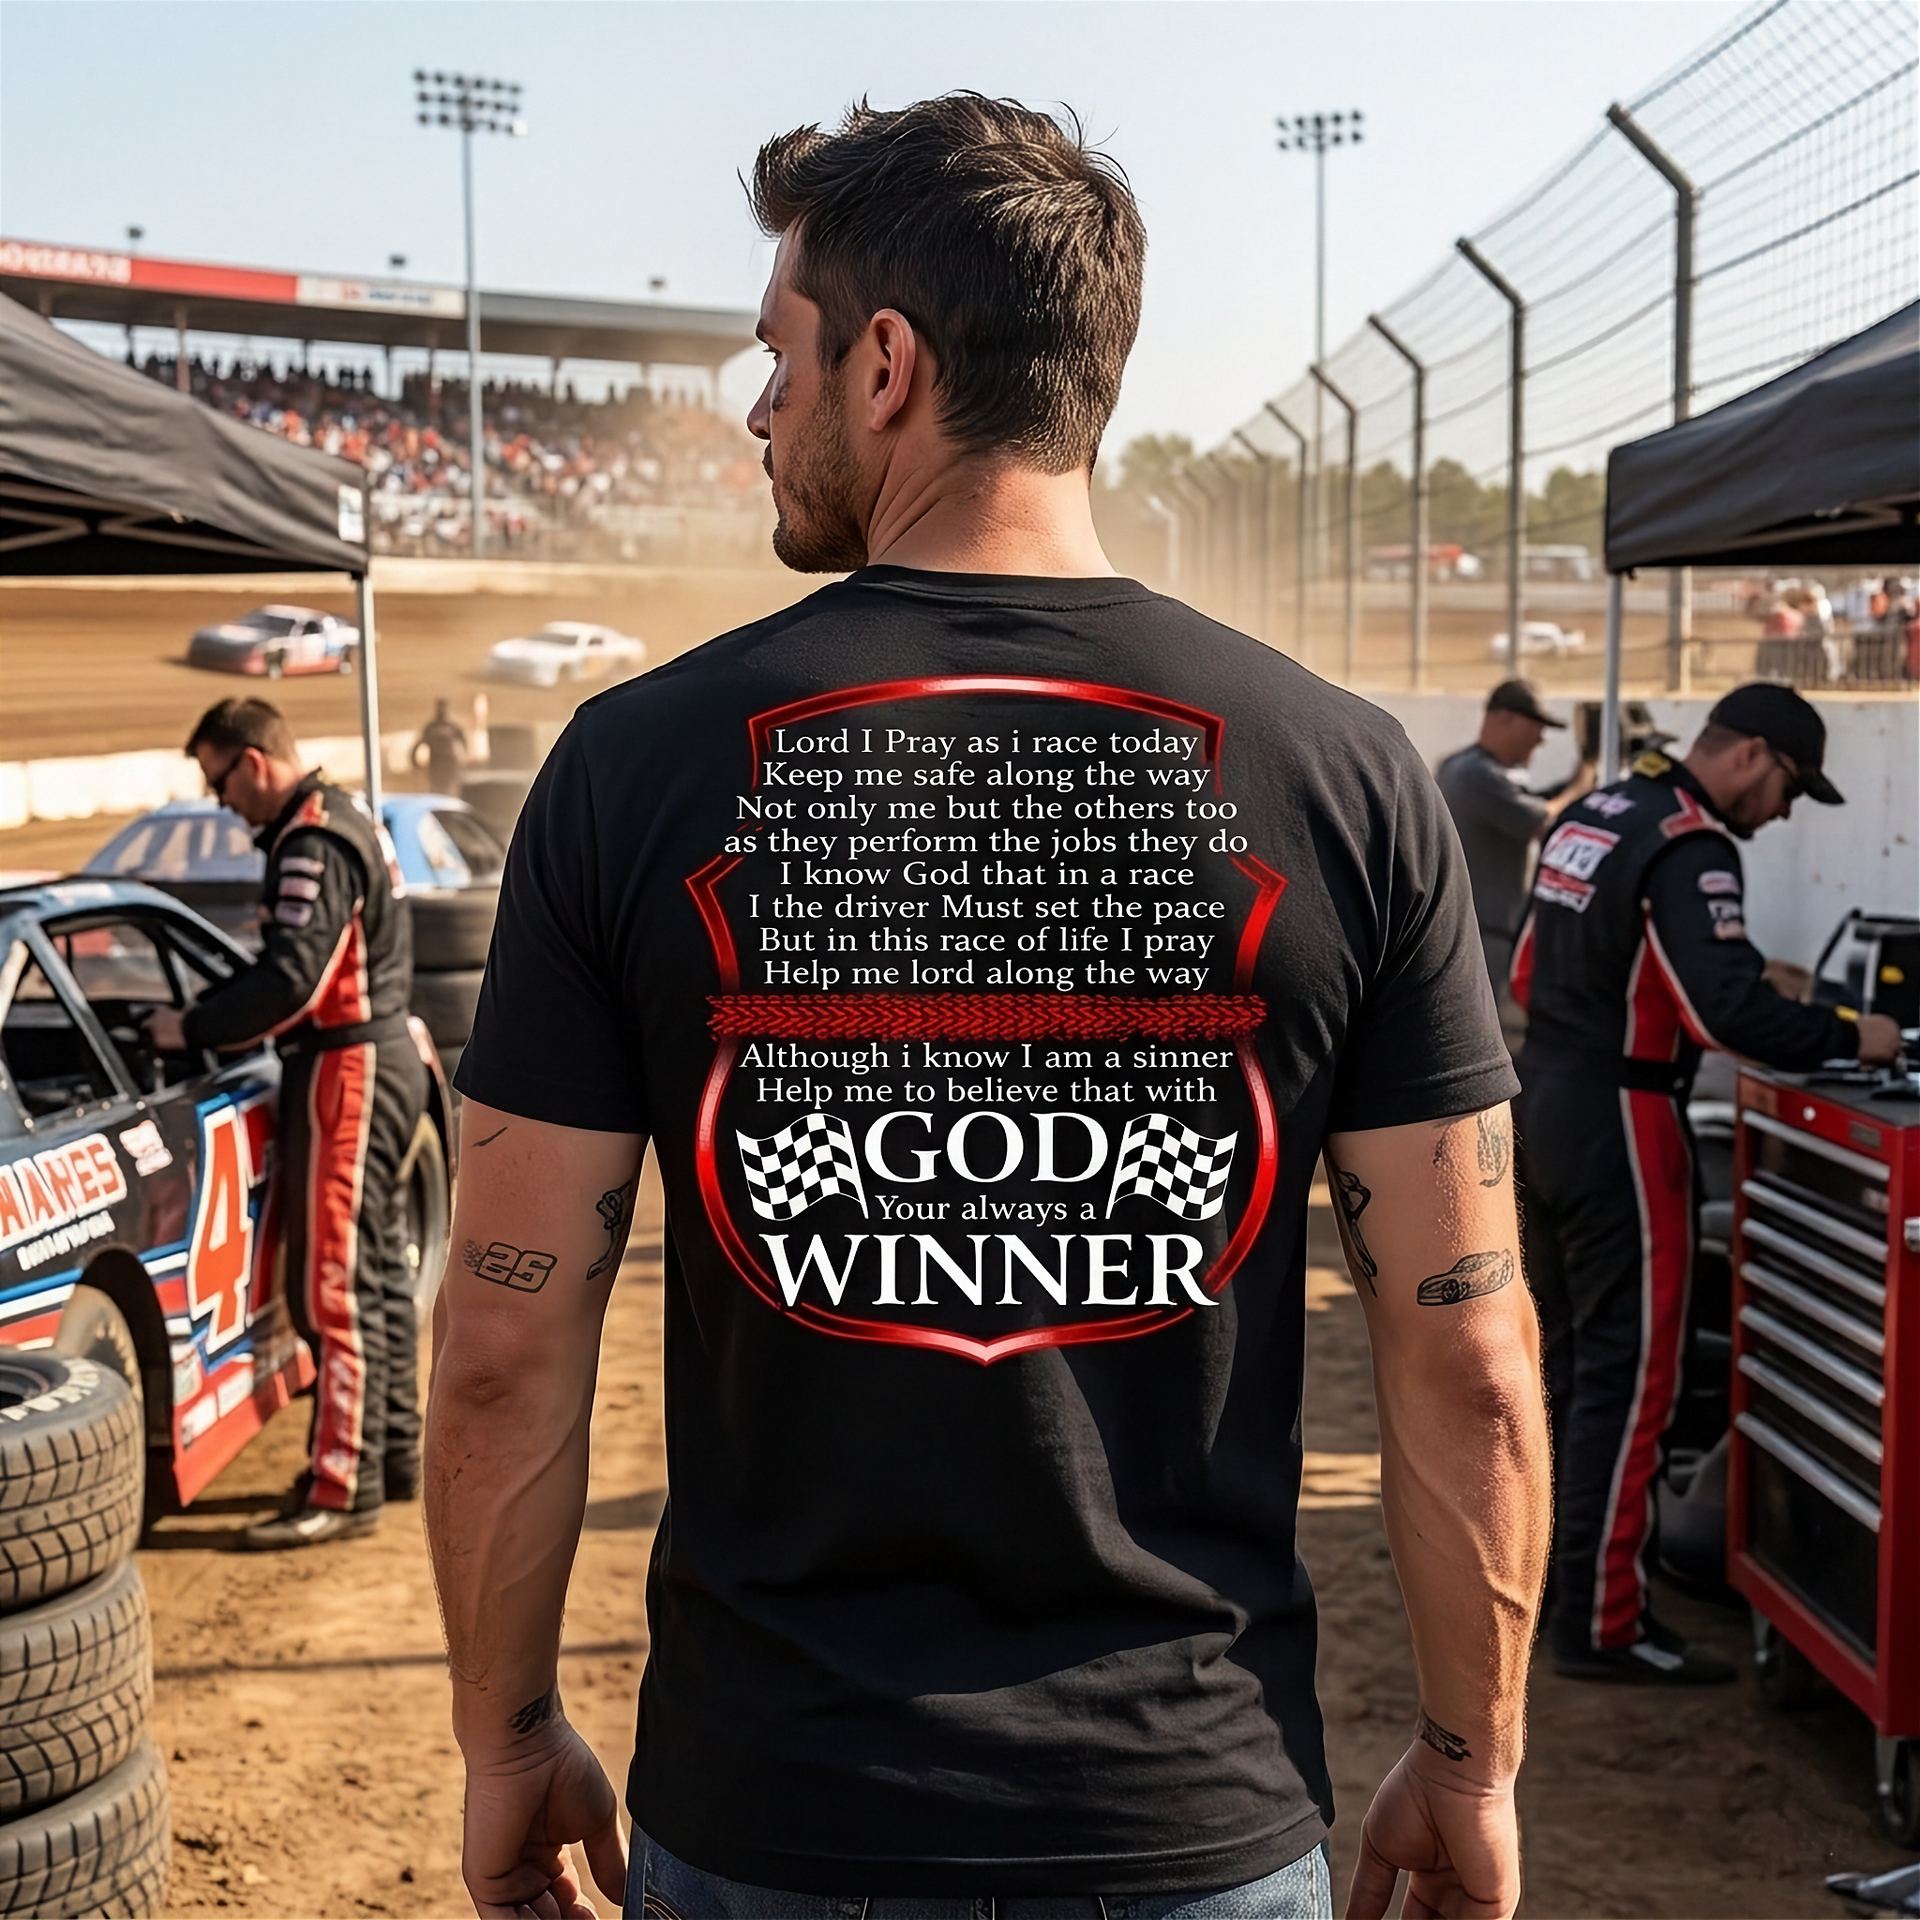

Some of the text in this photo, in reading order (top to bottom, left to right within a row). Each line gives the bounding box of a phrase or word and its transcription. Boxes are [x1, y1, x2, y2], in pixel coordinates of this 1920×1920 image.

[775, 727, 1199, 761] Lord I Pray as i race today
[762, 760, 1211, 793] Keep me safe along the way
[735, 793, 1238, 827] Not only me but the others too
[724, 827, 1248, 861] as they perform the jobs they do
[780, 860, 1194, 886] I know God that in a race
[748, 893, 1225, 926] I the driver Must set the pace
[759, 925, 1216, 959] But in this race of life I pray
[763, 958, 1210, 992] Help me lord along the way
[738, 1041, 1234, 1076] Although i know I am a sinner
[756, 1076, 1218, 1110] Help me to believe that with
[864, 1110, 1109, 1183] GOD
[874, 1194, 1097, 1228] Your always a
[187, 1104, 255, 1355] 4
[758, 1233, 1220, 1307] WINNER
